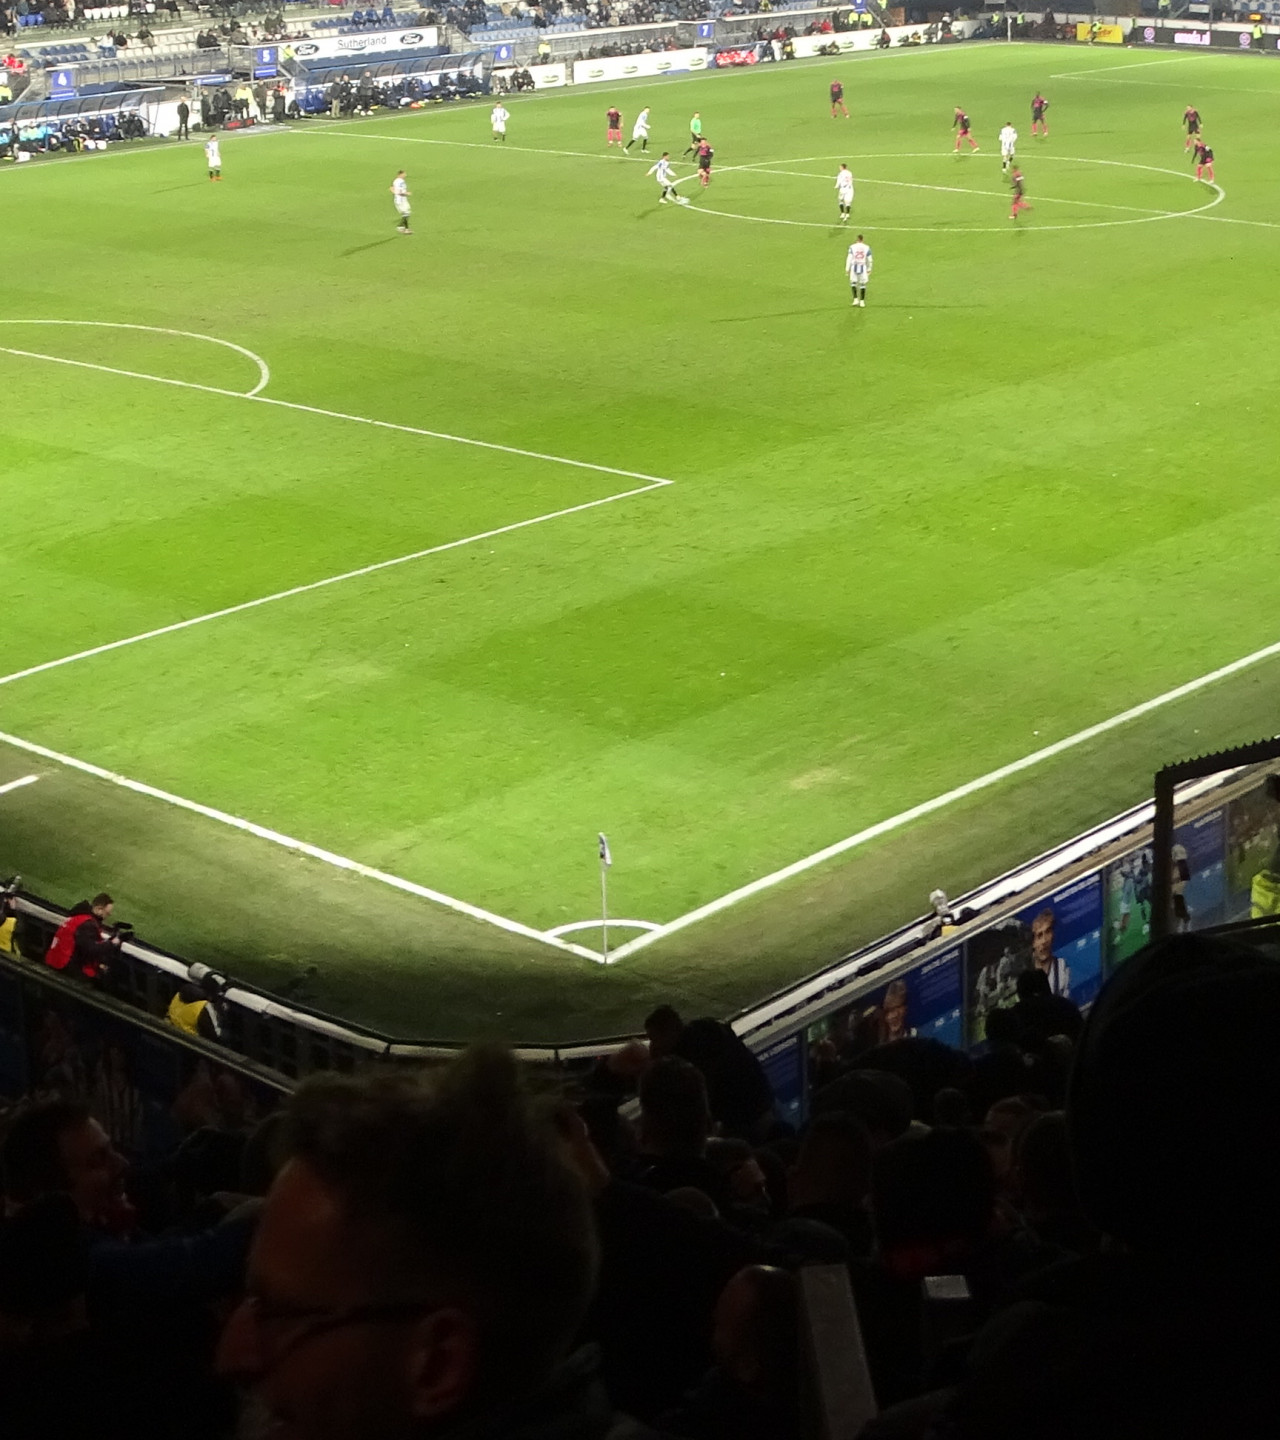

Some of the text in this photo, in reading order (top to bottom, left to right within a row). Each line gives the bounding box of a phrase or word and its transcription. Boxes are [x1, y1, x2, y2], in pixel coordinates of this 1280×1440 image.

[701, 24, 710, 37] 7
[337, 35, 388, 51] Sutherland
[262, 50, 271, 62] 5
[499, 46, 508, 58] 6
[58, 72, 68, 86] 4
